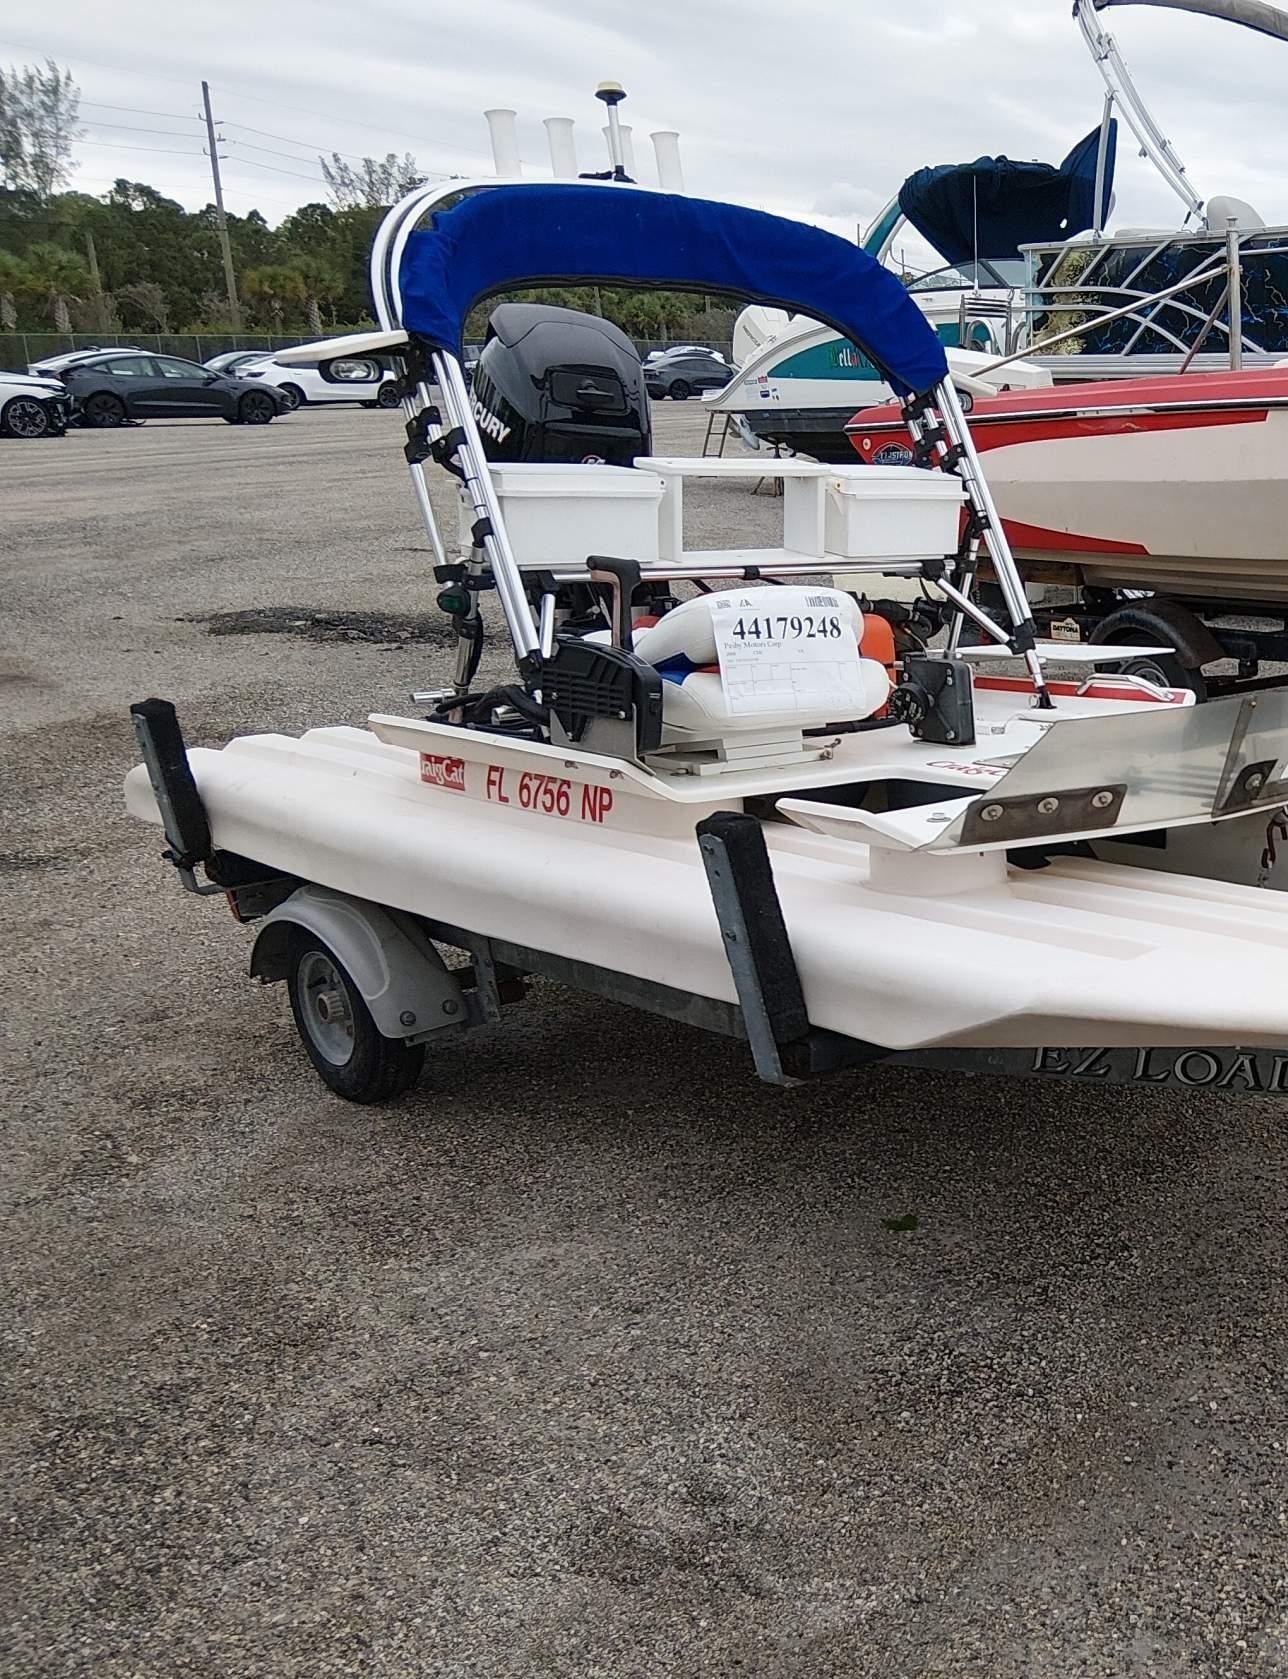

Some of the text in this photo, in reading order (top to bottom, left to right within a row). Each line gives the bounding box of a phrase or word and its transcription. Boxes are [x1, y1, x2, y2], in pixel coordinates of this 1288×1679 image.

[733, 616, 842, 640] 44179248
[487, 765, 613, 823] FL 6756 NP
[1031, 1046, 1110, 1077] EZ
